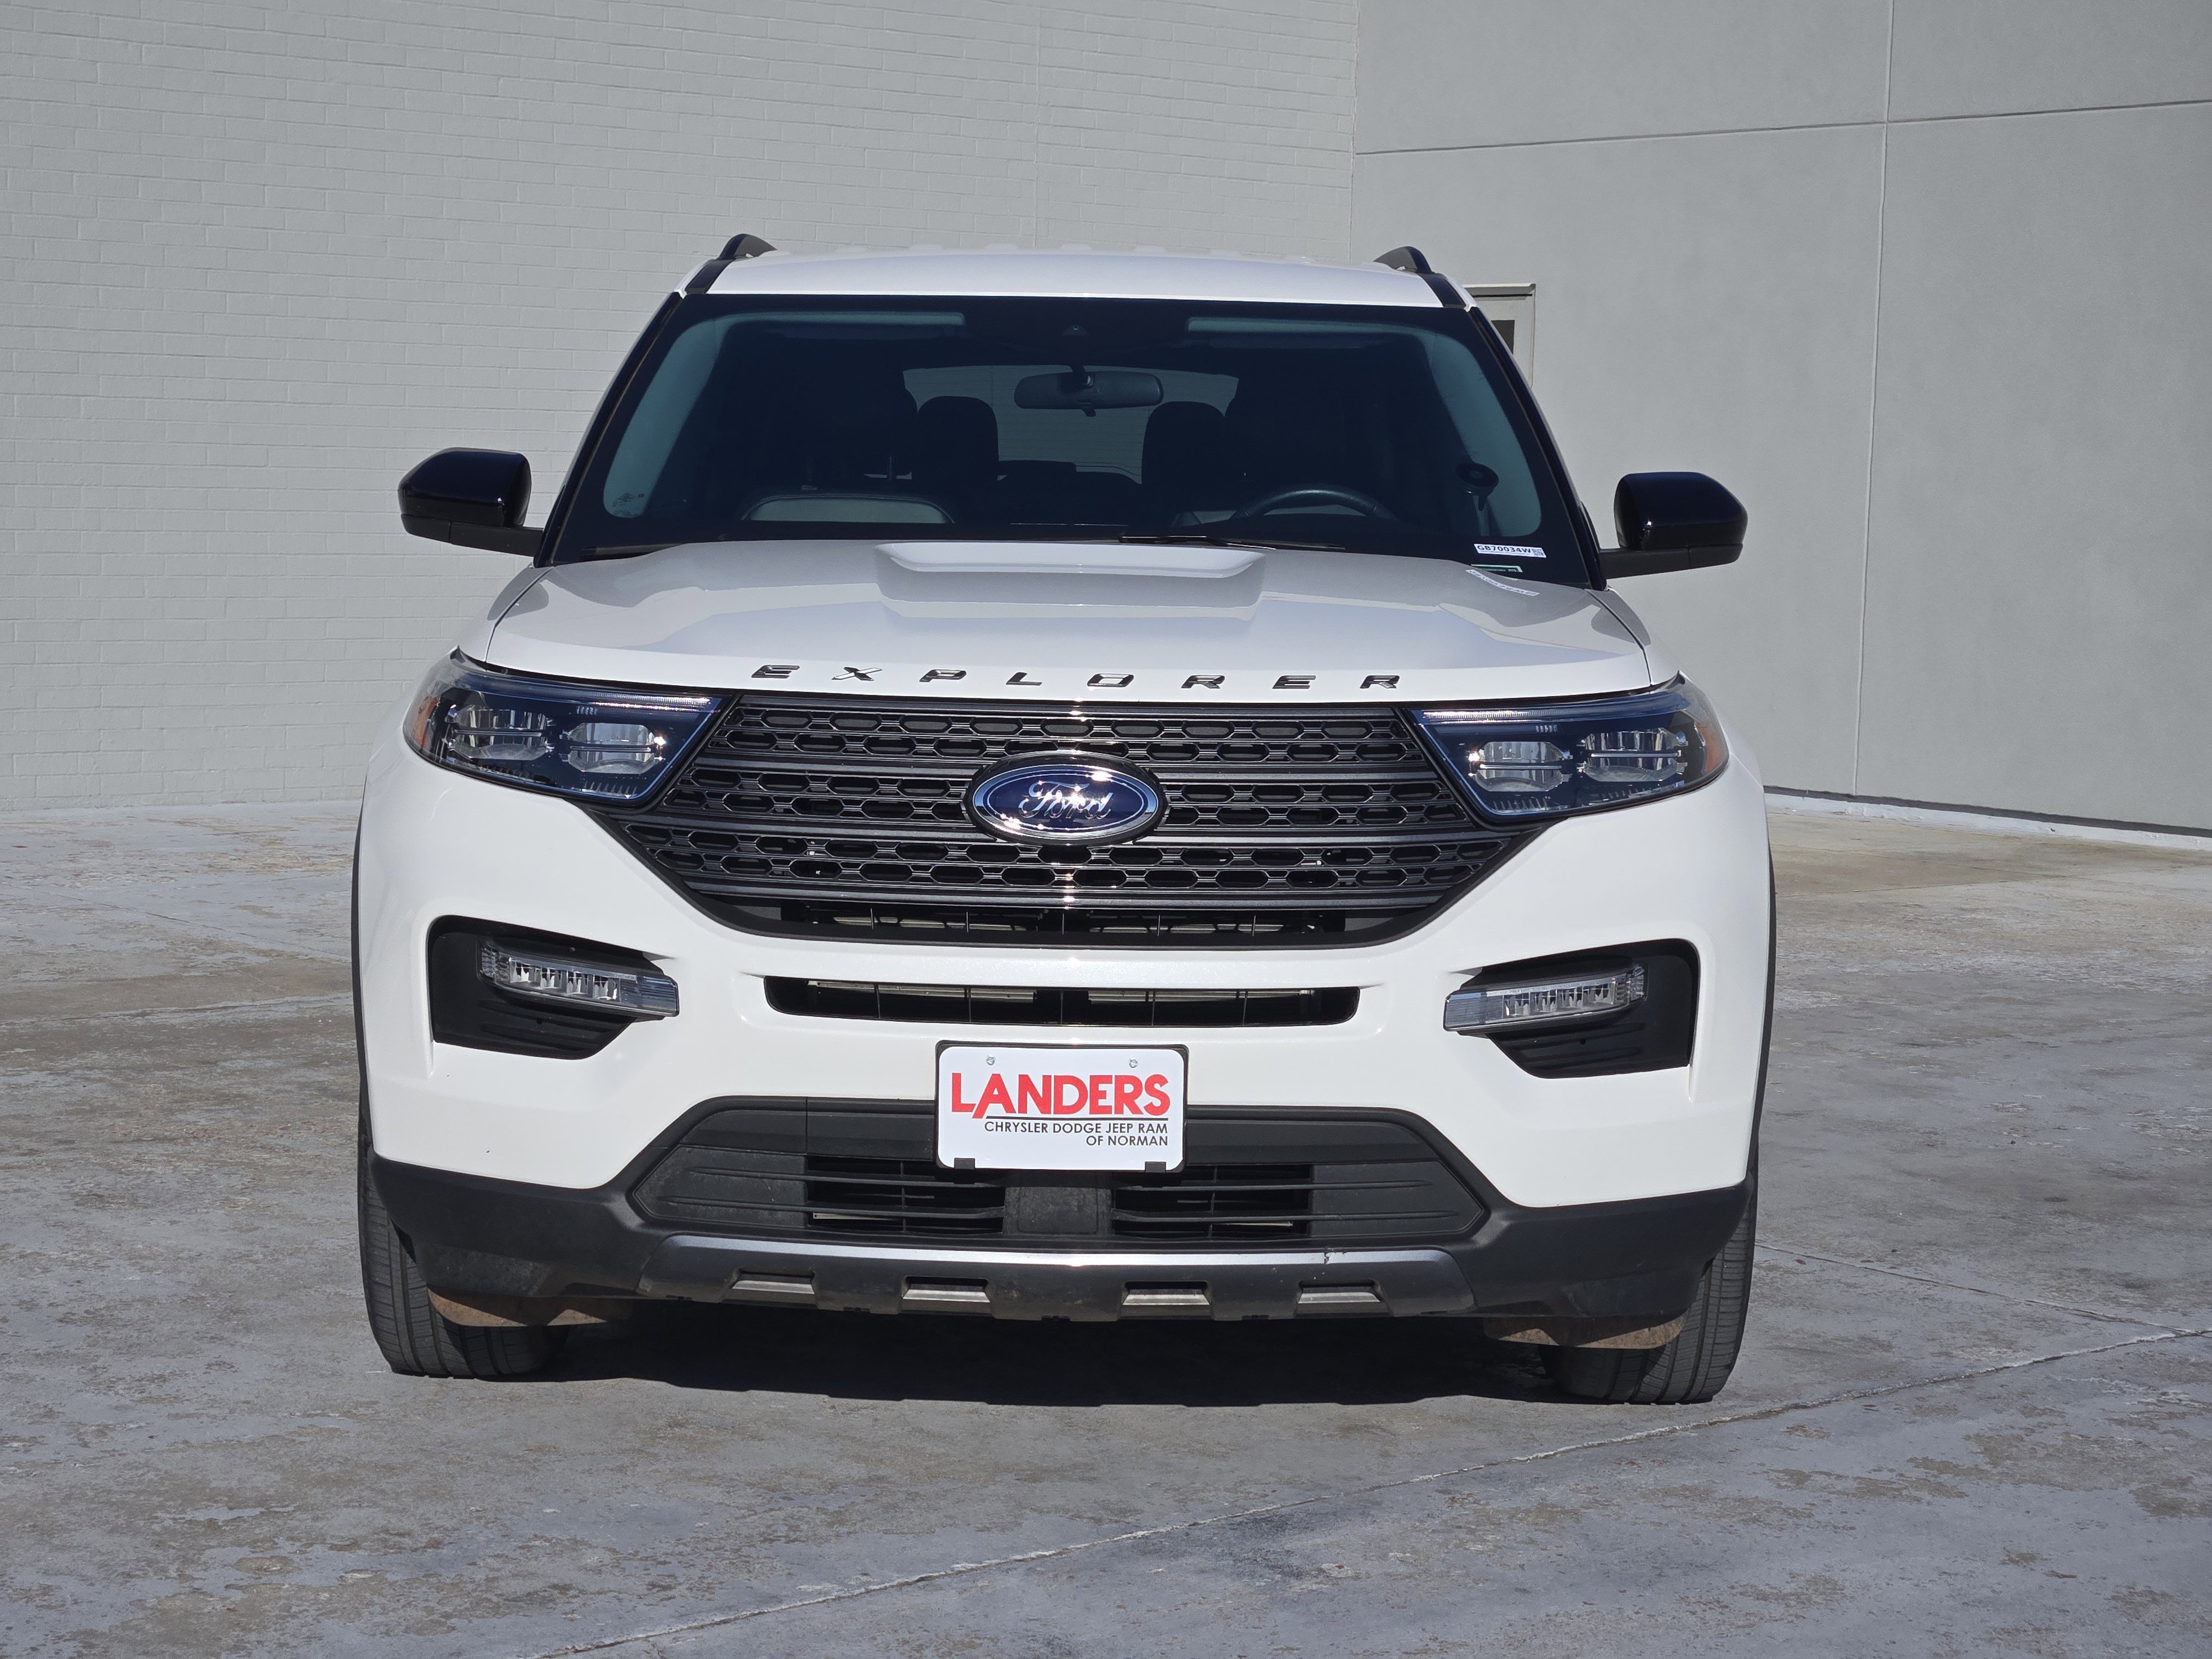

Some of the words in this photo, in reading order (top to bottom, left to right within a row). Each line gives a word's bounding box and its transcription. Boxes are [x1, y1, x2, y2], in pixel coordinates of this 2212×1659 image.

[751, 664, 1400, 689] EXPLORER
[1018, 780, 1114, 820] Ford
[952, 1072, 1171, 1119] LANDERS
[984, 1121, 1048, 1133] CHRYSLER
[1053, 1123, 1102, 1134] DODGE
[1105, 1124, 1133, 1134] JEEP
[1139, 1124, 1168, 1134] RAM
[1086, 1136, 1104, 1146] OF
[1108, 1136, 1168, 1146] NORMAN
